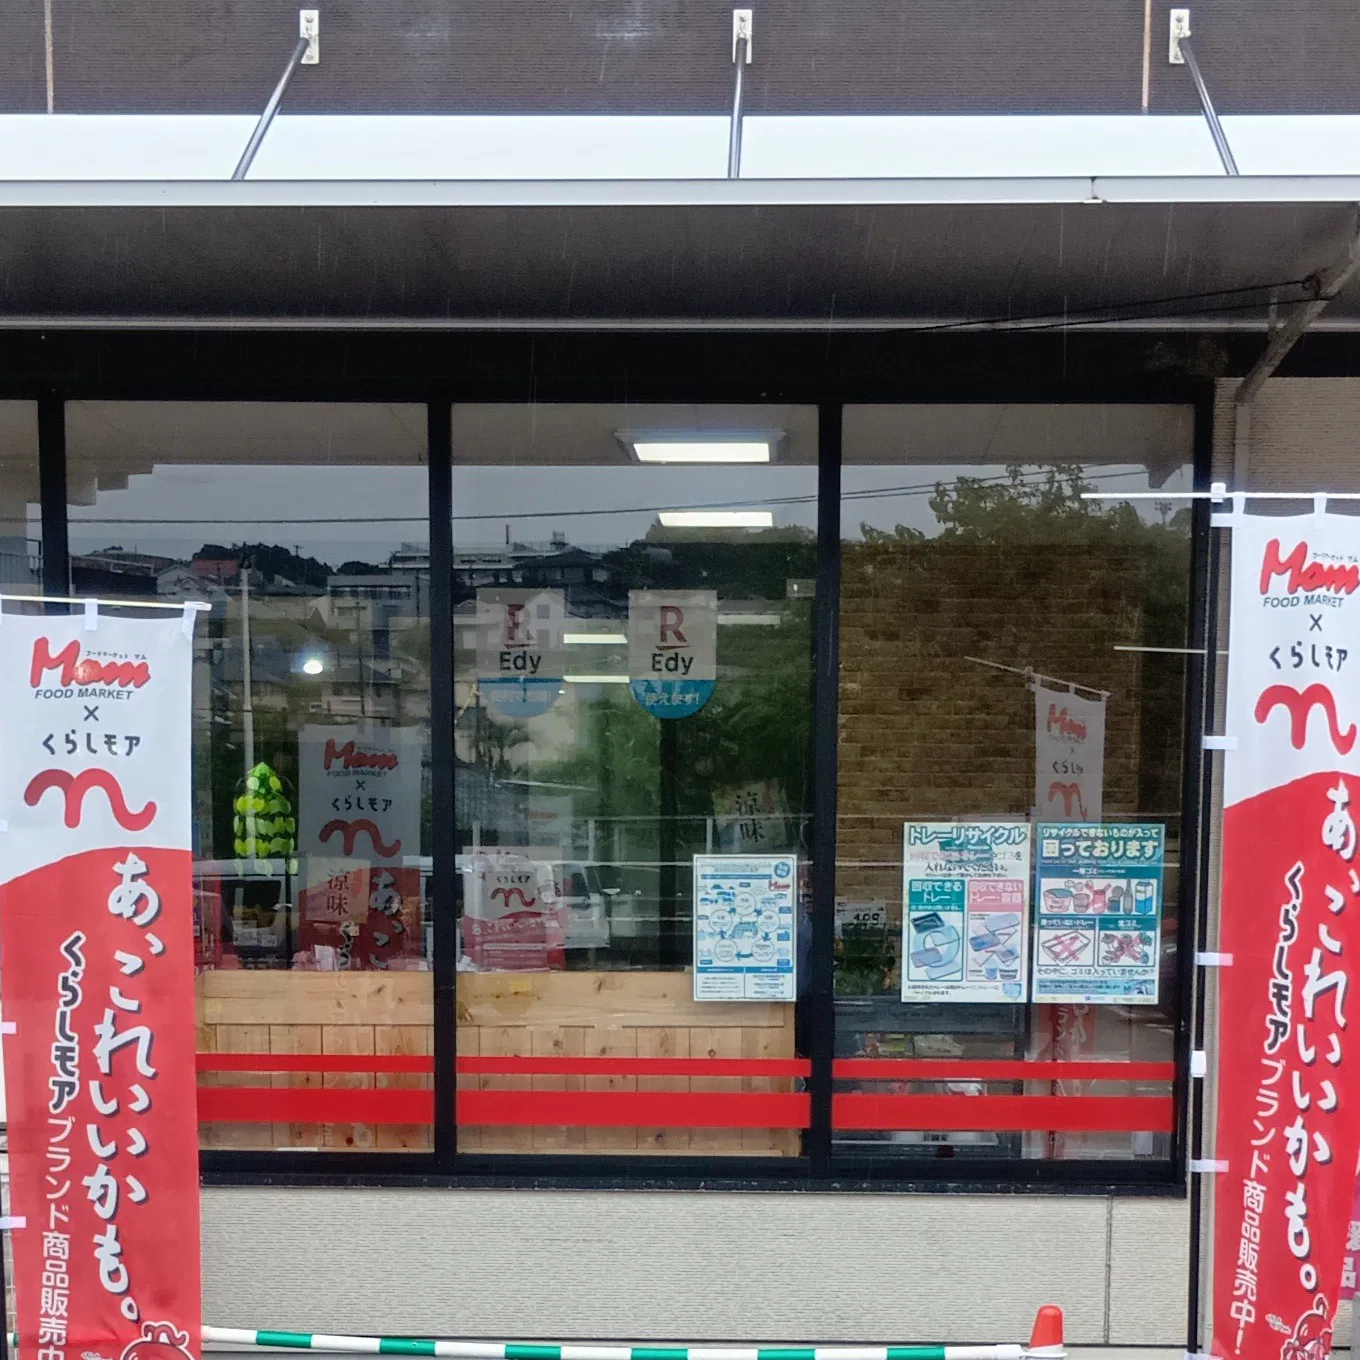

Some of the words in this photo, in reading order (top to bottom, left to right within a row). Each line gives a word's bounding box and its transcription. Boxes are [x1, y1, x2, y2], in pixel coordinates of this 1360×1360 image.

[1262, 597, 1300, 608] FOOD
[1304, 595, 1345, 609] MARKET
[499, 651, 541, 674] Edy
[651, 653, 694, 675] Edy
[1270, 640, 1348, 672] くらしモア
[34, 689, 73, 700] FOOD
[77, 688, 134, 700] MARKET
[42, 729, 141, 756] くらしモア
[332, 797, 393, 812] くらしモア
[909, 826, 1027, 845] トレーリサイクル
[1042, 839, 1159, 858] 困っております
[923, 892, 951, 903] トレー
